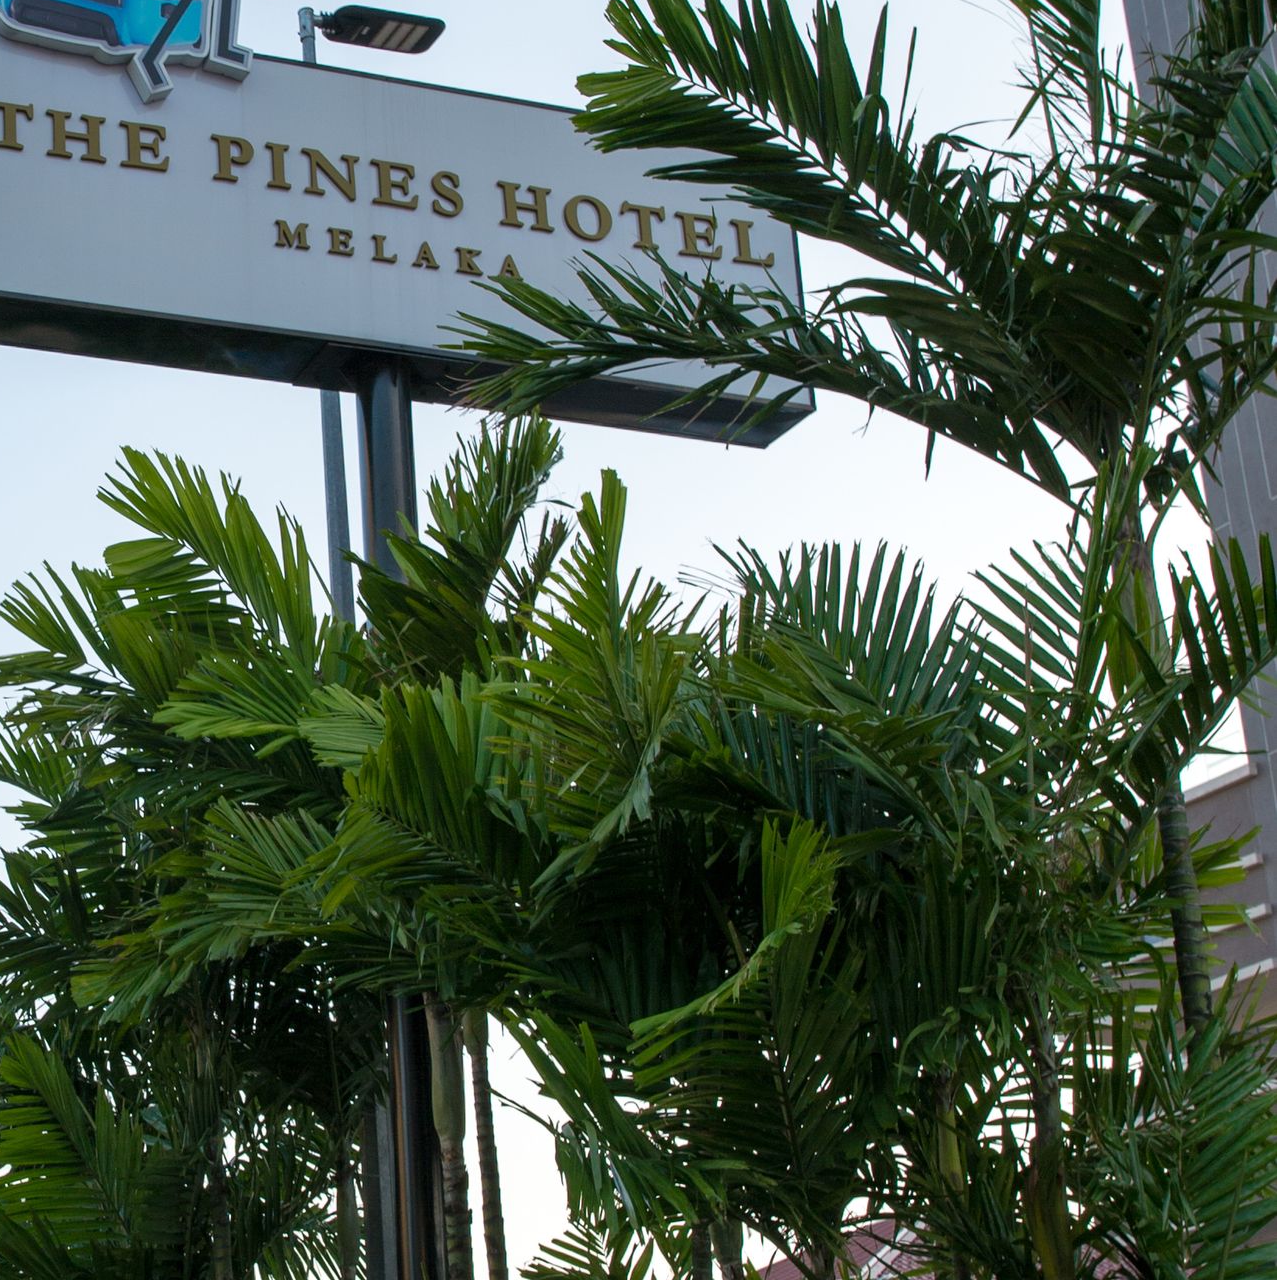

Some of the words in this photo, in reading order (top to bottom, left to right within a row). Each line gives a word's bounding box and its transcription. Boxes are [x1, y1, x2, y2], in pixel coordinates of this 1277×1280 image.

[210, 133, 464, 218] PINES
[495, 179, 776, 269] HOTEL
[274, 219, 524, 280] MELAKA
